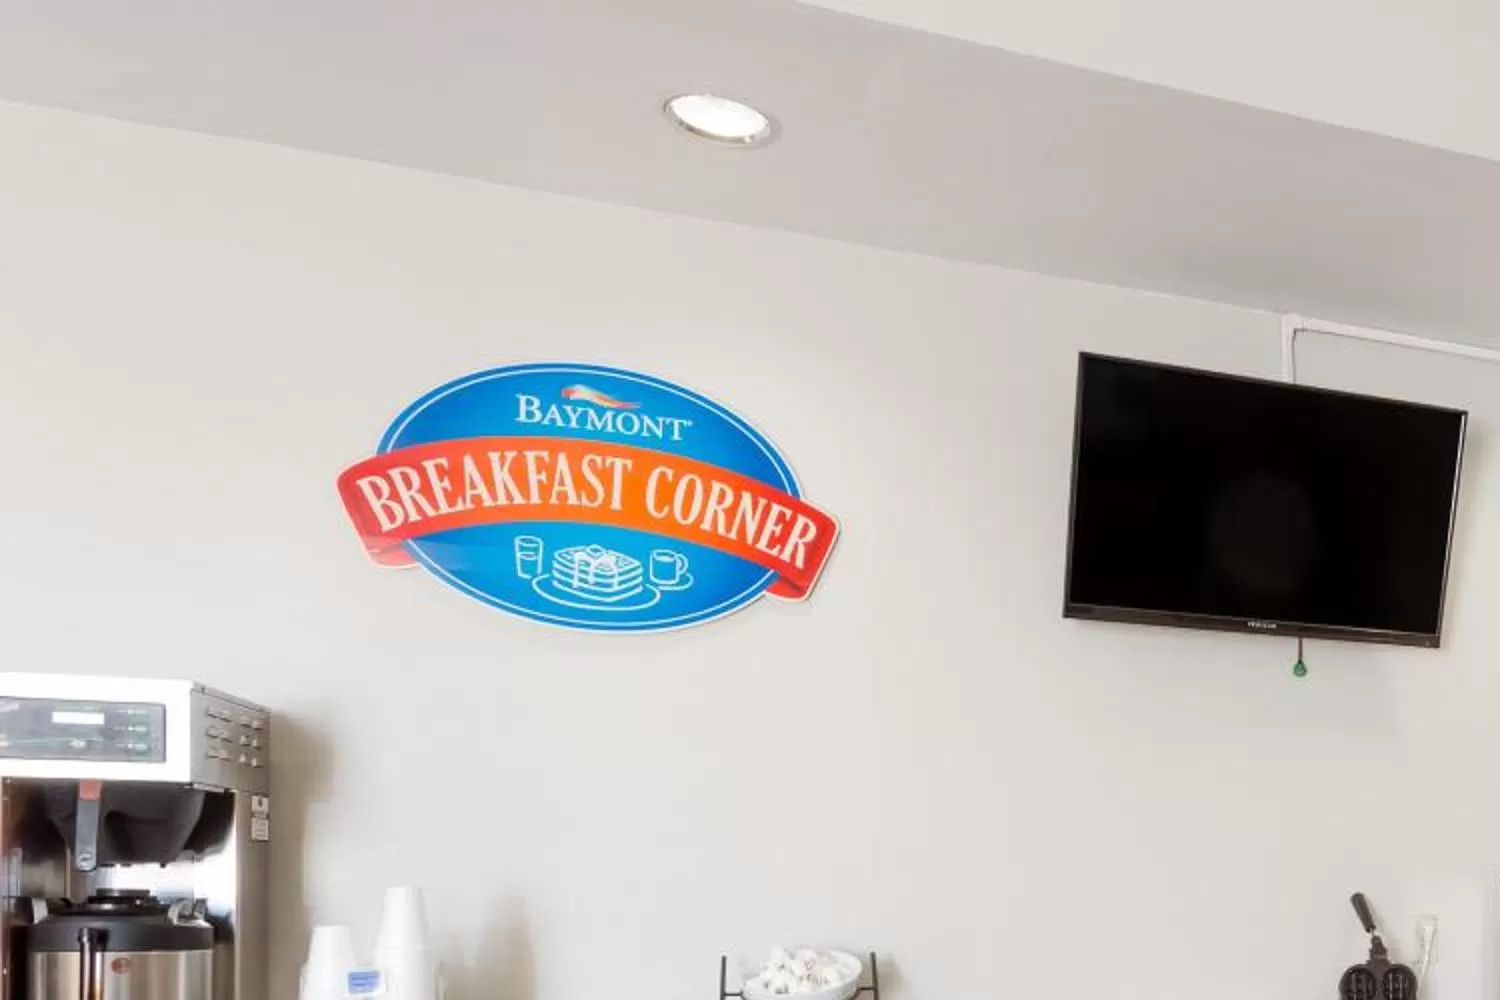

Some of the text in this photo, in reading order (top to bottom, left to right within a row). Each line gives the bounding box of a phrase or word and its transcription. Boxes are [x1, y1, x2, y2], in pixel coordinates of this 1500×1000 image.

[515, 393, 687, 441] BAYMONT
[356, 450, 817, 569] BREAKFAST CORNER
